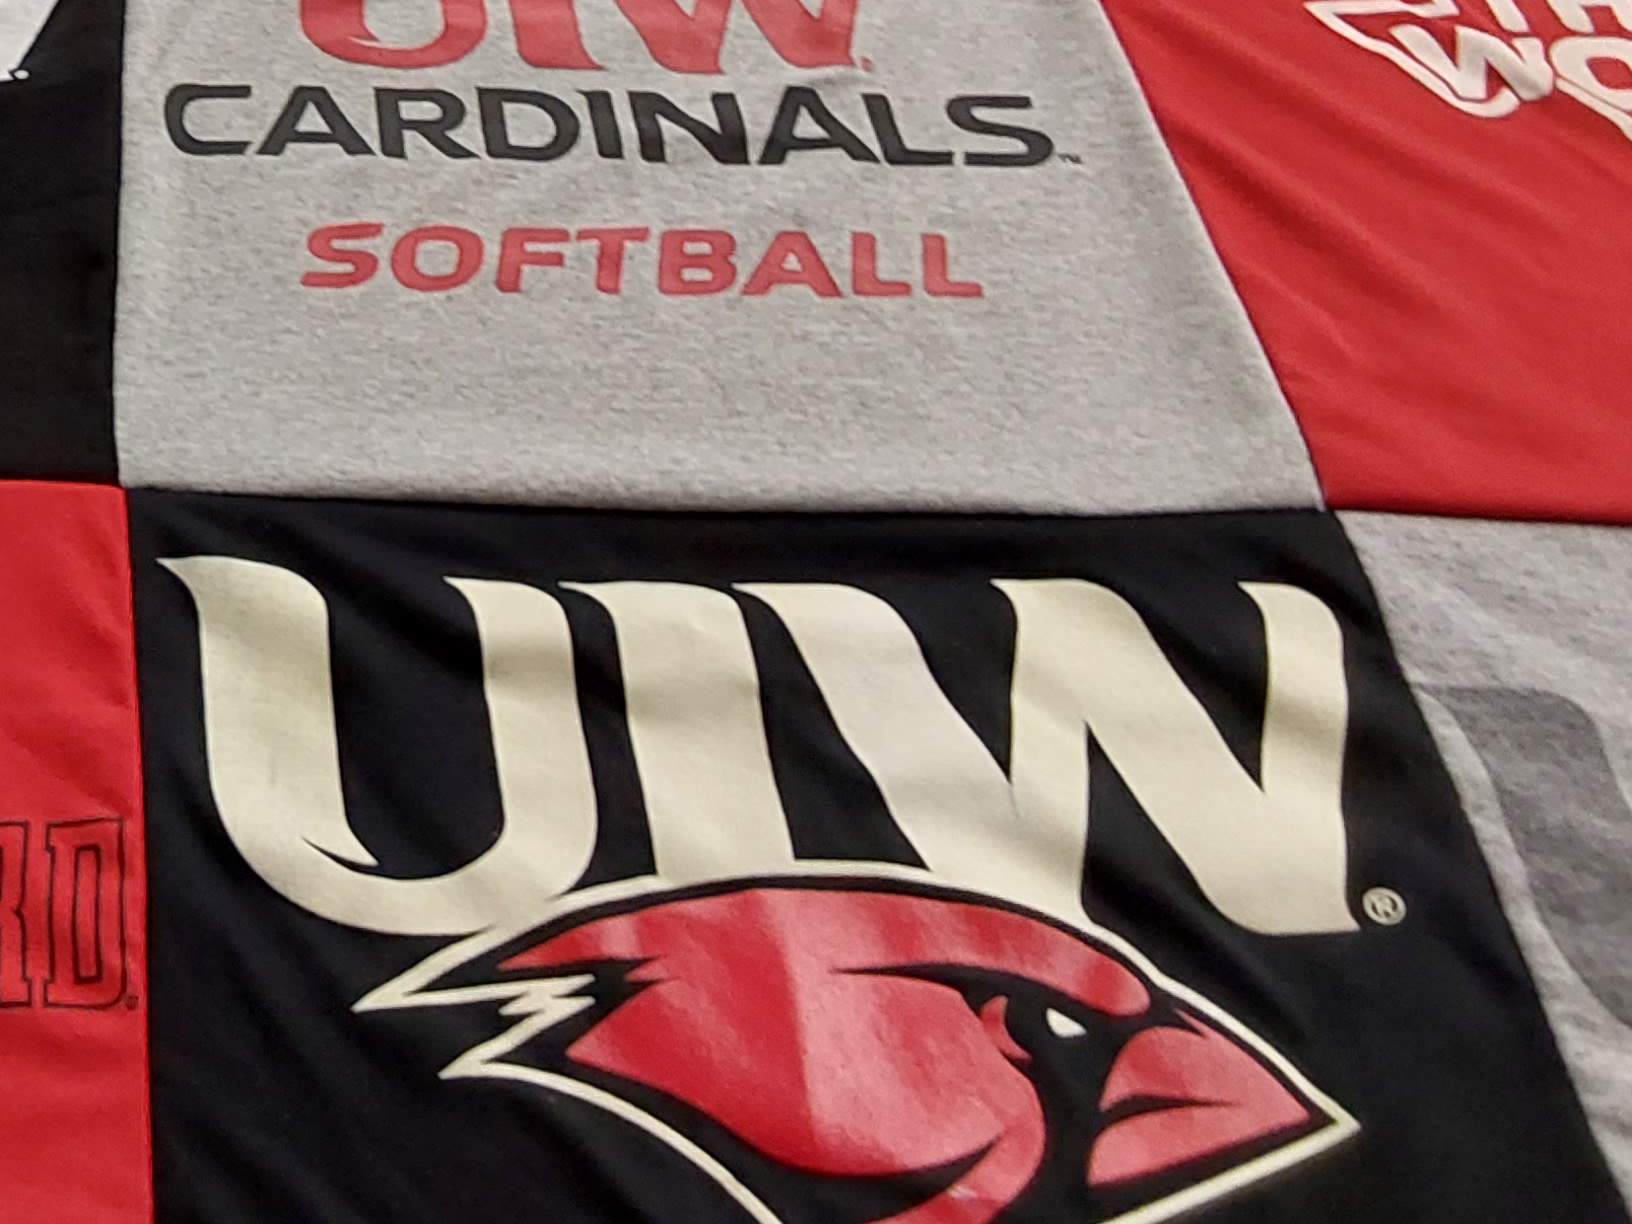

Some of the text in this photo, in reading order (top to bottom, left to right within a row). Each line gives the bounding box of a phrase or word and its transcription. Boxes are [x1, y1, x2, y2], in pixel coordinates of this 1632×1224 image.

[163, 83, 1056, 167] CARDINALS
[300, 222, 984, 298] SOFTBALL
[157, 555, 1362, 937] UIW
